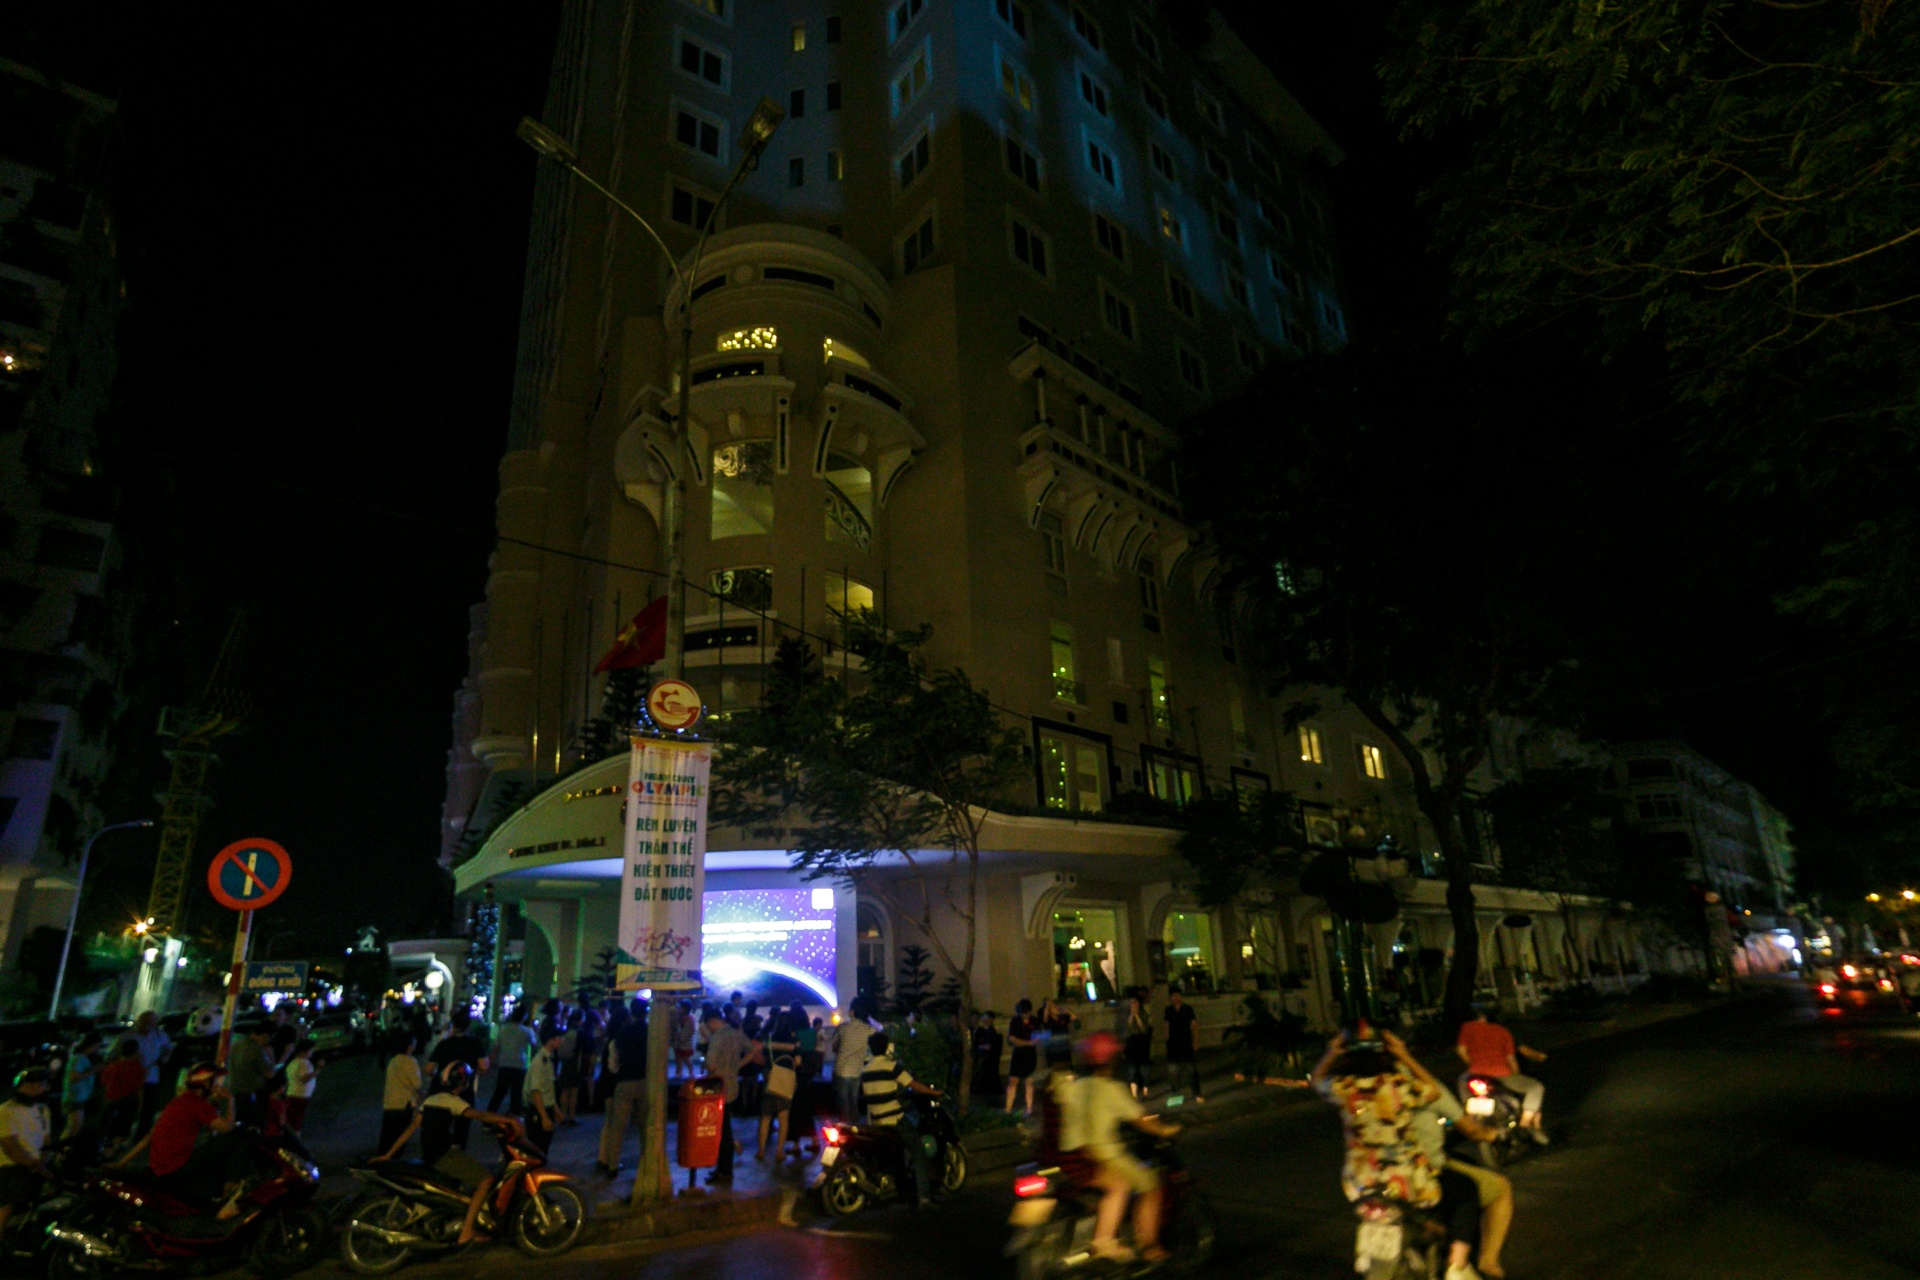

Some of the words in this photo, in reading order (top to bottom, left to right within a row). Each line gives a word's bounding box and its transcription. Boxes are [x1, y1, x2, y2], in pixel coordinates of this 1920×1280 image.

[631, 780, 705, 797] OLYMPIC
[636, 816, 659, 832] RÈN
[639, 838, 669, 855] THÂN
[665, 860, 696, 878] THIẾT
[661, 884, 693, 902] NƯỚC
